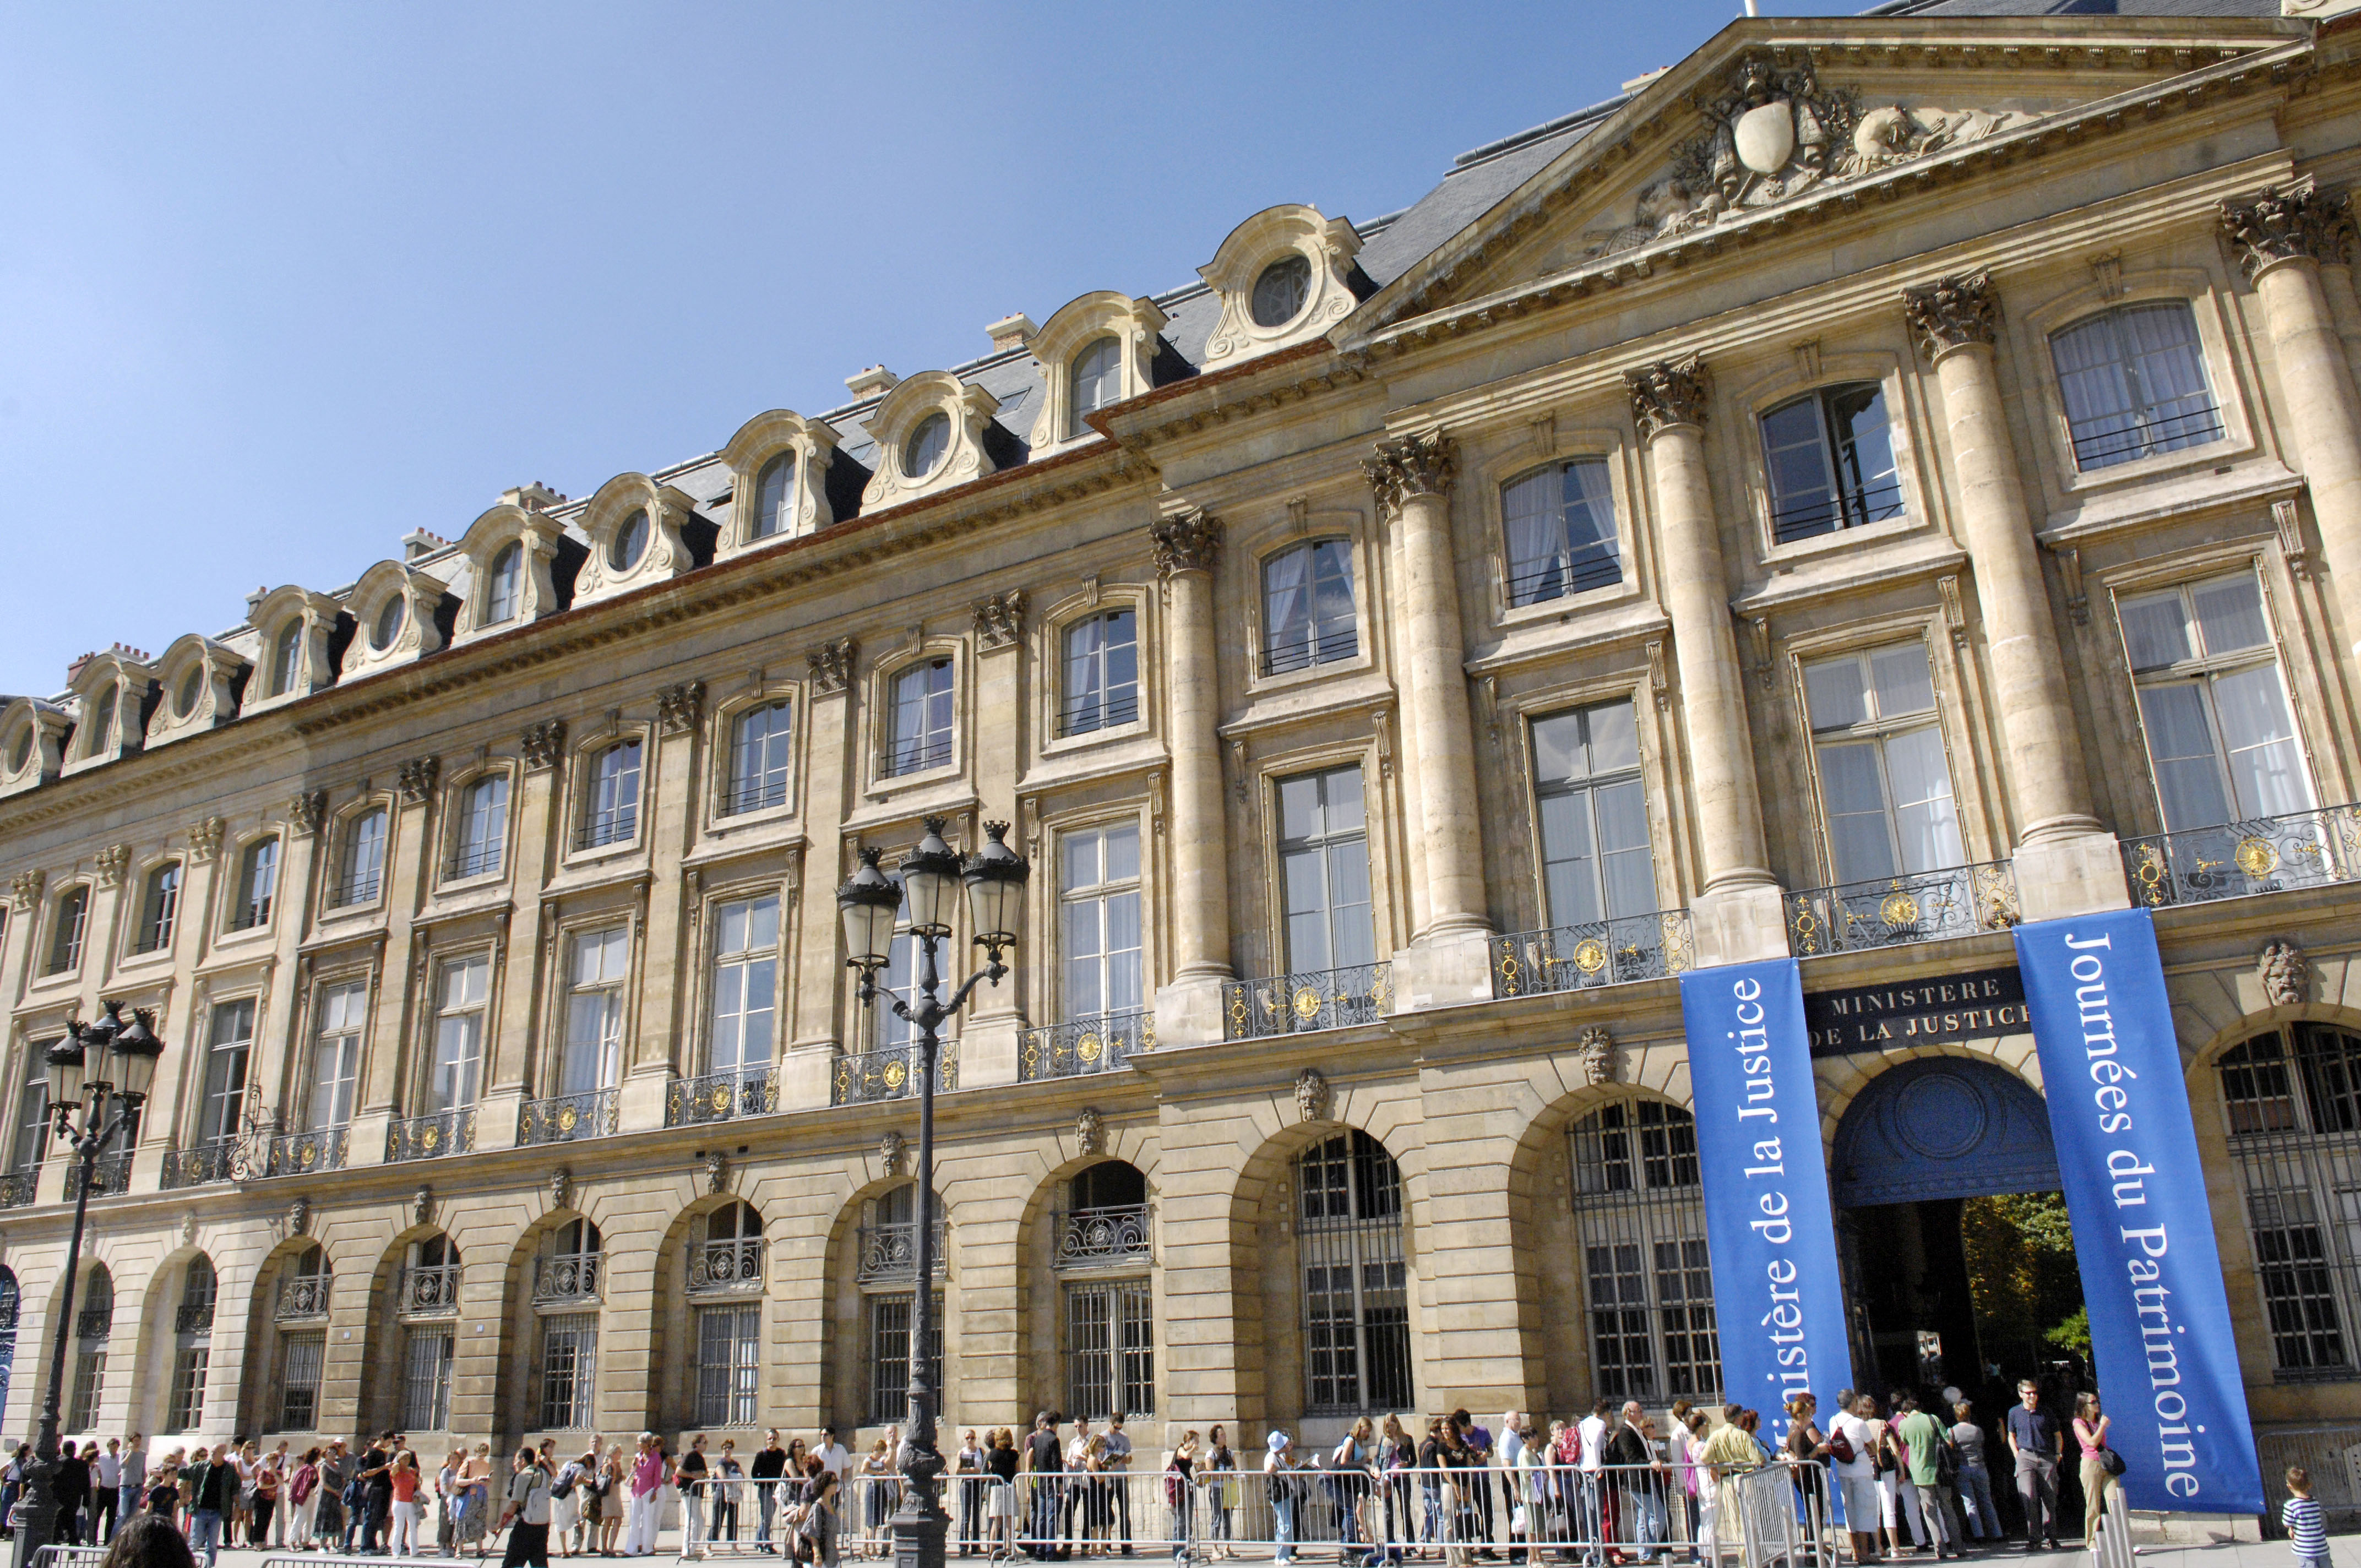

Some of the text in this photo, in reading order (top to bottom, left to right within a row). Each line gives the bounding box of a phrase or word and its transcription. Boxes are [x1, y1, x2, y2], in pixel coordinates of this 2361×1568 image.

[1831, 979, 2000, 1015] MINISTERE
[1727, 978, 1778, 1124] Justice
[1808, 1028, 1842, 1047] DE
[1859, 1022, 1892, 1042] LA
[1744, 1136, 1785, 1179] la
[1749, 1191, 1792, 1244] de
[2065, 933, 2206, 1497] Journées du Patrimoine
